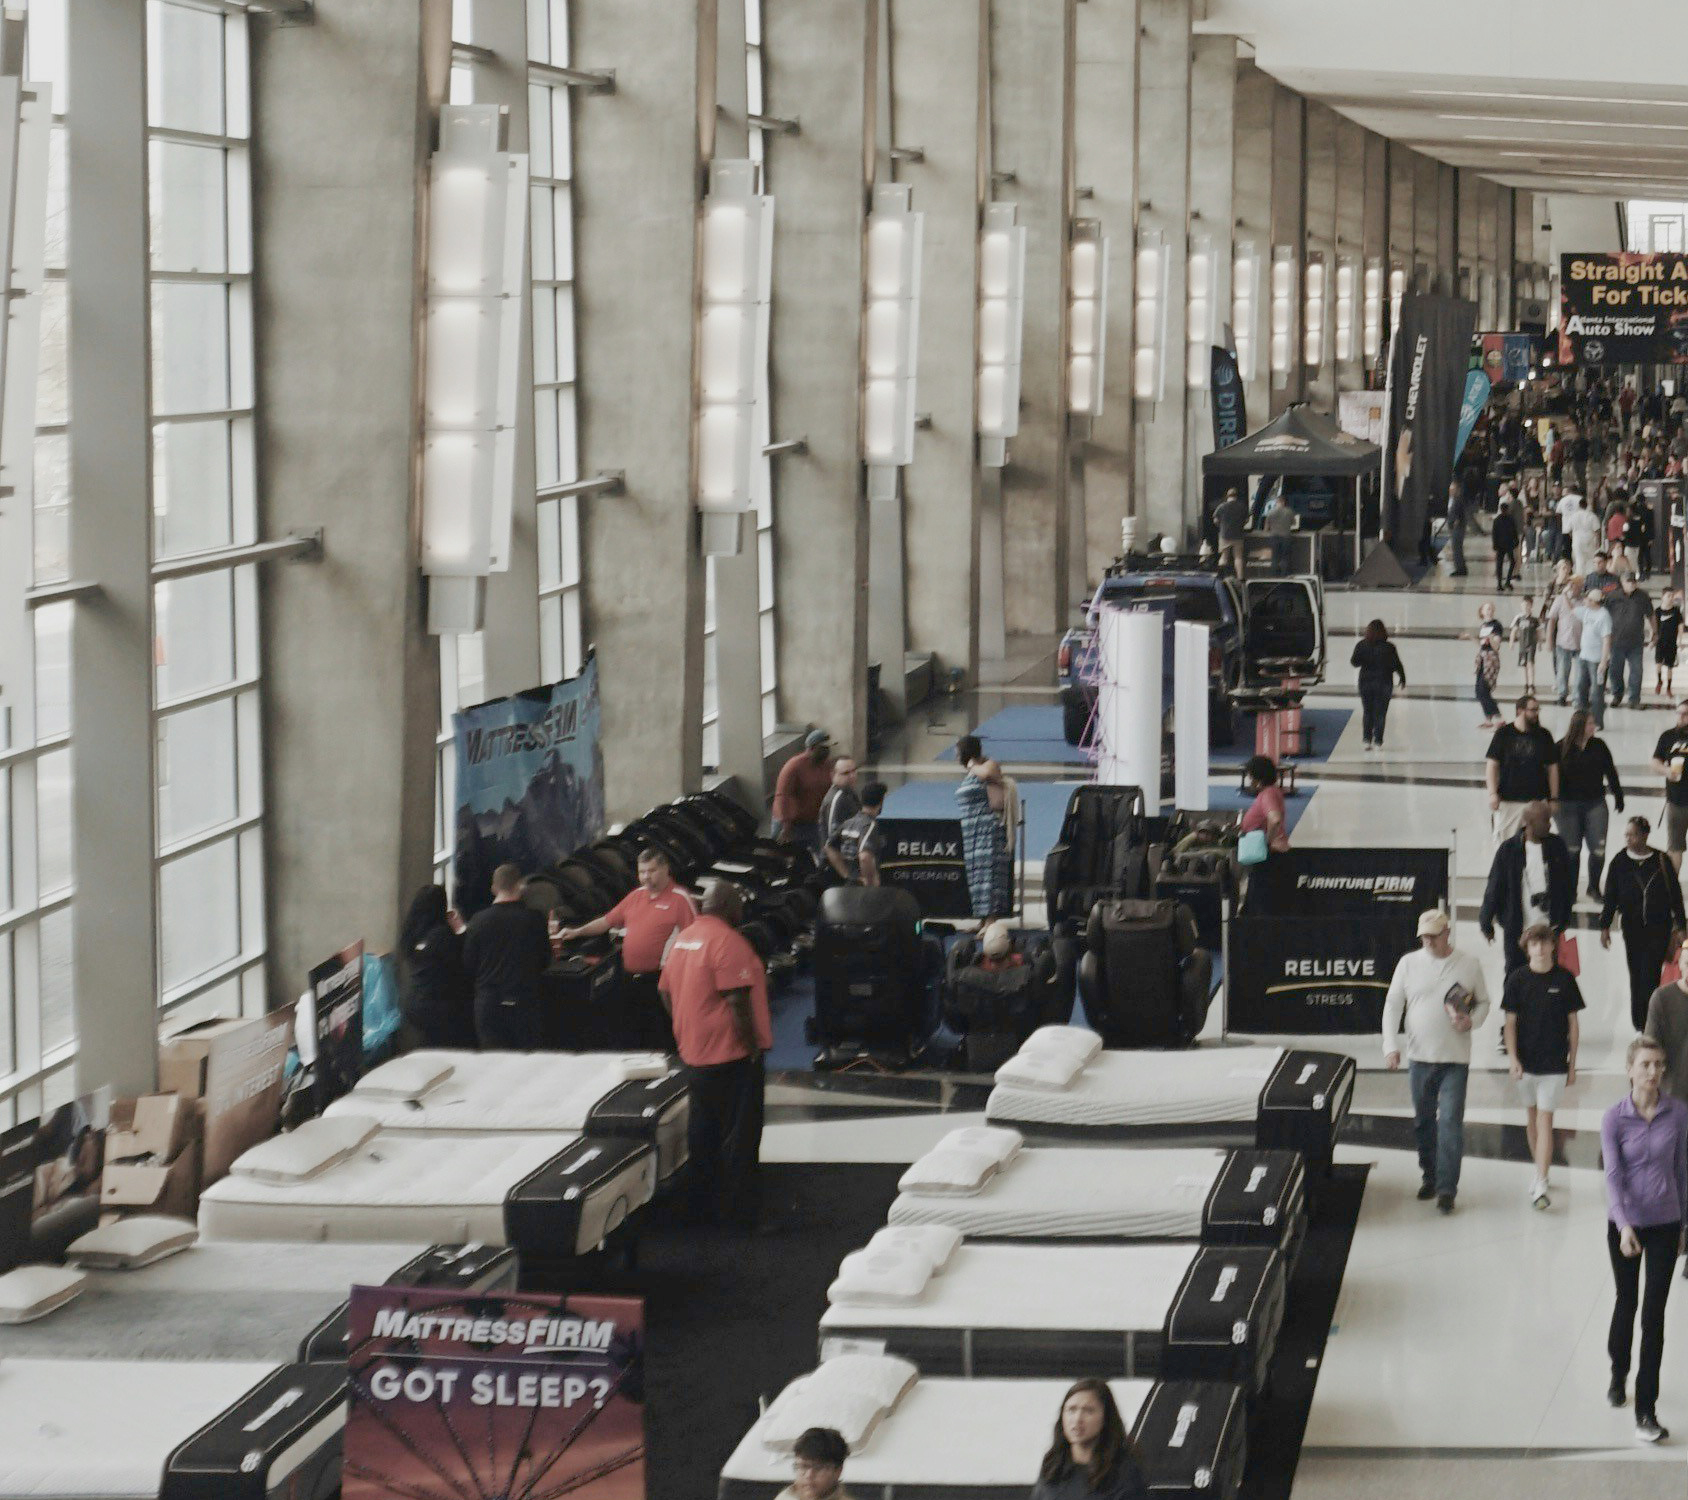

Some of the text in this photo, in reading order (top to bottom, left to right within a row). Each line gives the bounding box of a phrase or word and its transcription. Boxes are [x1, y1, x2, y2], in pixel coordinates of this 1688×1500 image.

[1570, 261, 1665, 284] Straight
[1592, 286, 1632, 305] For
[1565, 315, 1656, 336] Auto Show
[897, 841, 958, 856] RELAX
[1285, 959, 1375, 976] RELIEVE
[1306, 993, 1354, 1005] STRESS
[371, 1367, 609, 1409] GOT SLEEP?
